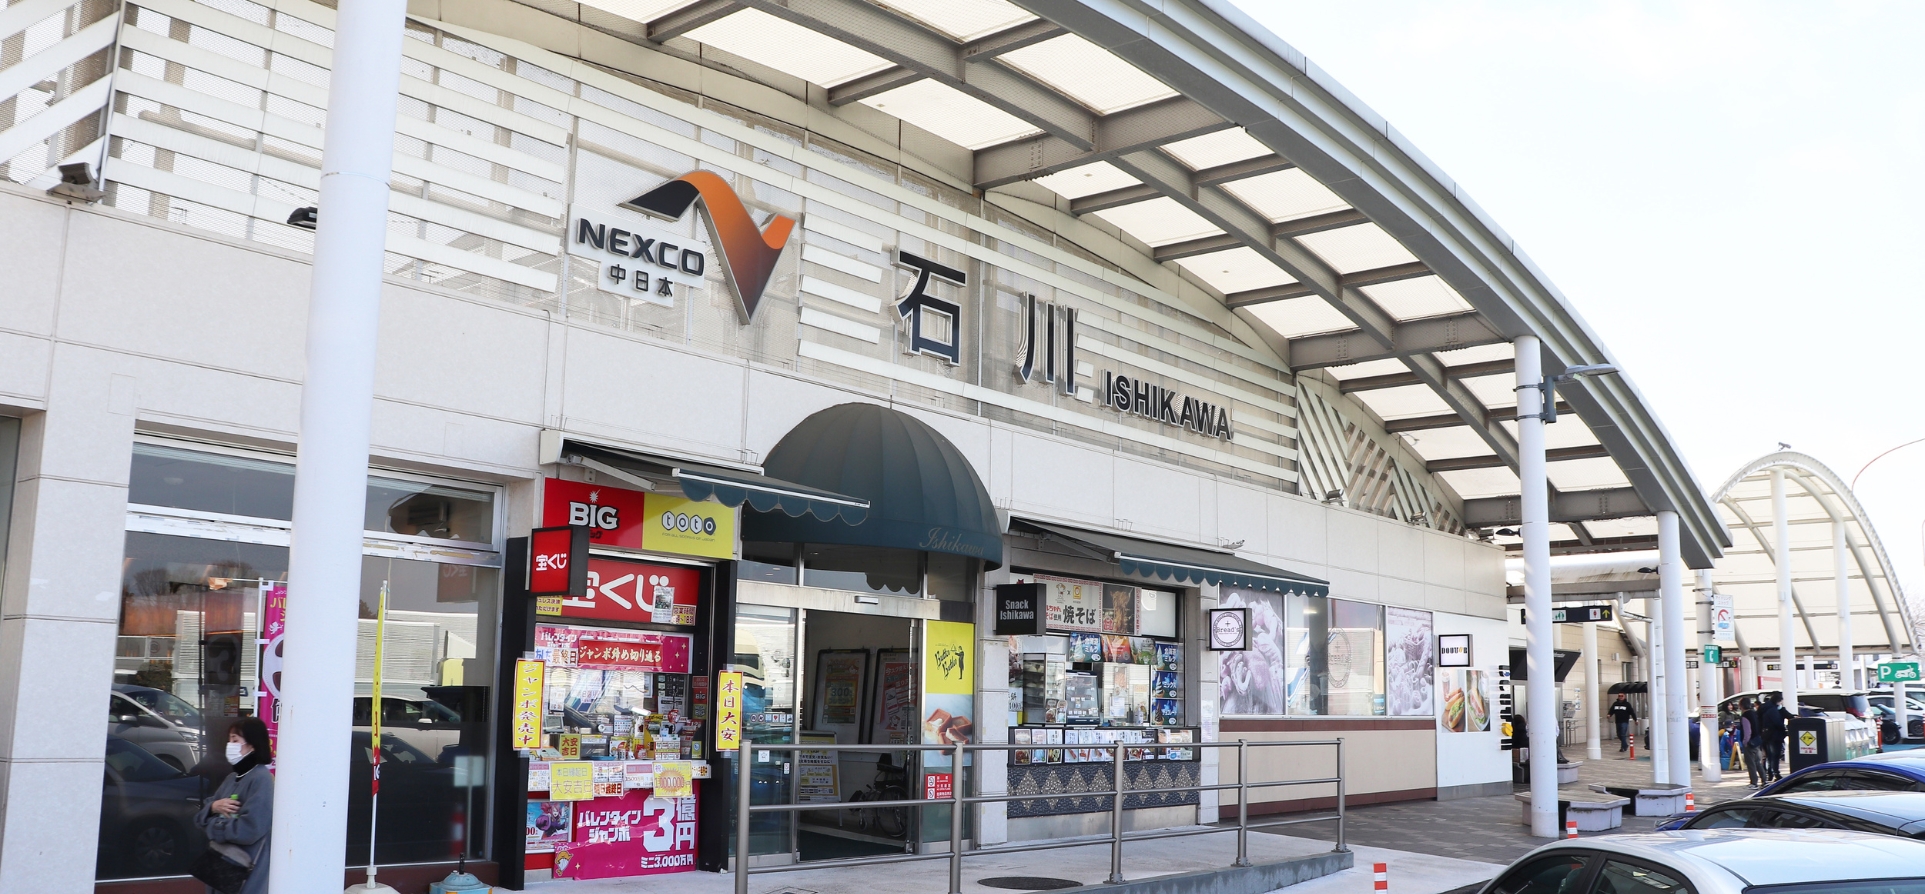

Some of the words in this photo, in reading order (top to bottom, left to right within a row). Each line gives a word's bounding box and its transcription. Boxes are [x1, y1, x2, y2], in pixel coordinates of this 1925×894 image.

[578, 217, 706, 277] NEXCO
[608, 263, 675, 300] 中日本
[893, 249, 1079, 396] 石川
[1103, 369, 1234, 441] ISHIKAWA
[569, 501, 619, 530] BIG
[663, 511, 715, 535] toto
[919, 527, 984, 555] Ishikawa
[536, 553, 567, 571] 宝くじ
[1005, 599, 1029, 610] Snack
[1000, 610, 1034, 620] Ishikawa
[1063, 604, 1096, 625] 焼そば
[1880, 666, 1891, 679] P
[720, 678, 738, 742] 本日大安
[562, 737, 578, 747] 大安
[562, 747, 578, 756] 吉日
[552, 780, 592, 794] 大安吉日
[577, 810, 641, 828] バレンタイン
[588, 826, 631, 843] ジャンボ
